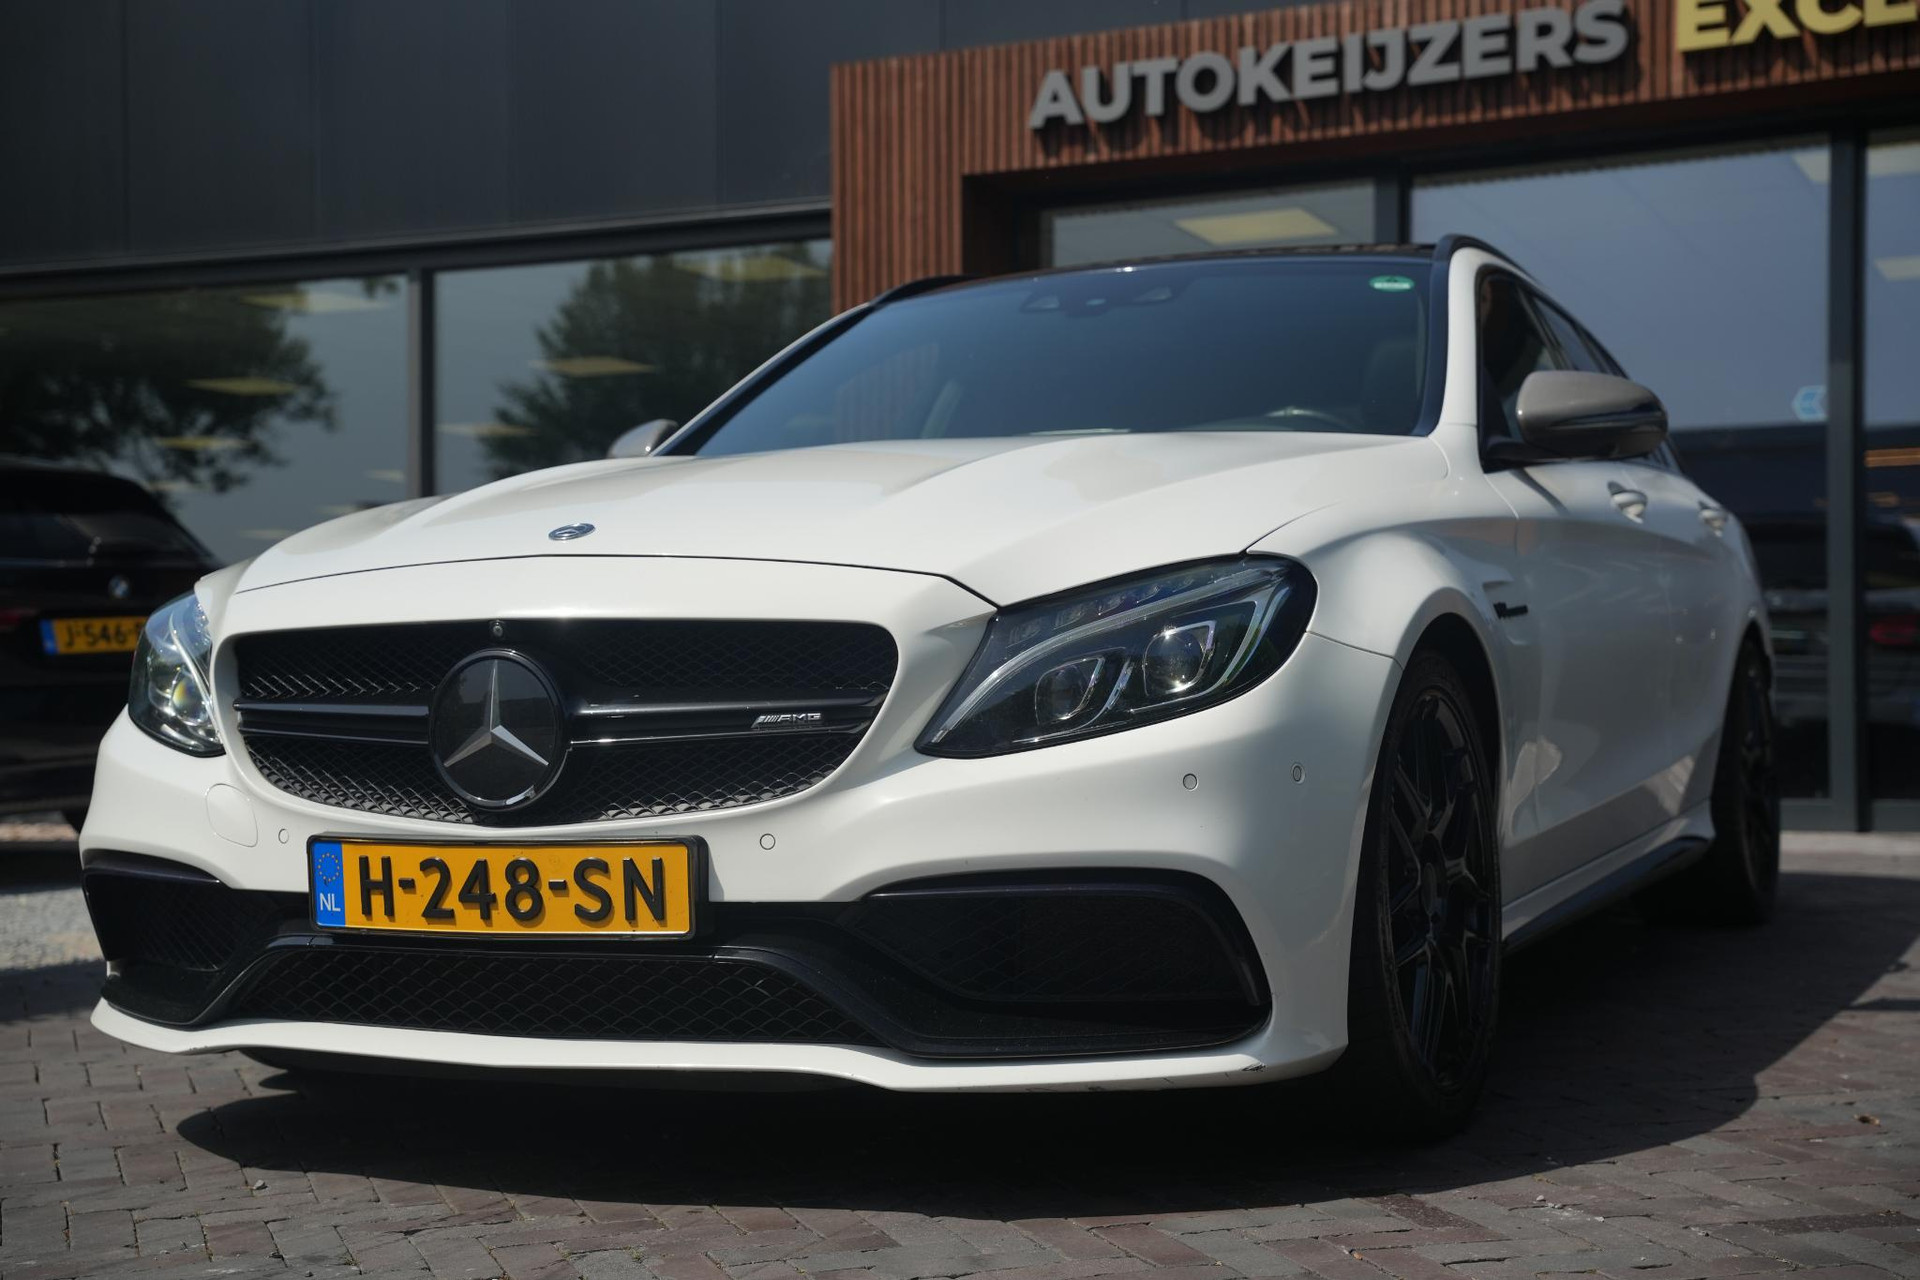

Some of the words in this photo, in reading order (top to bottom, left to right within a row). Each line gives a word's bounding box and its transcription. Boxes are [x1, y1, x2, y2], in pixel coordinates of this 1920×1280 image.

[1028, 0, 1629, 128] AUTOKEIJZERS
[320, 892, 341, 911] NL
[358, 855, 666, 921] H-248-SN
